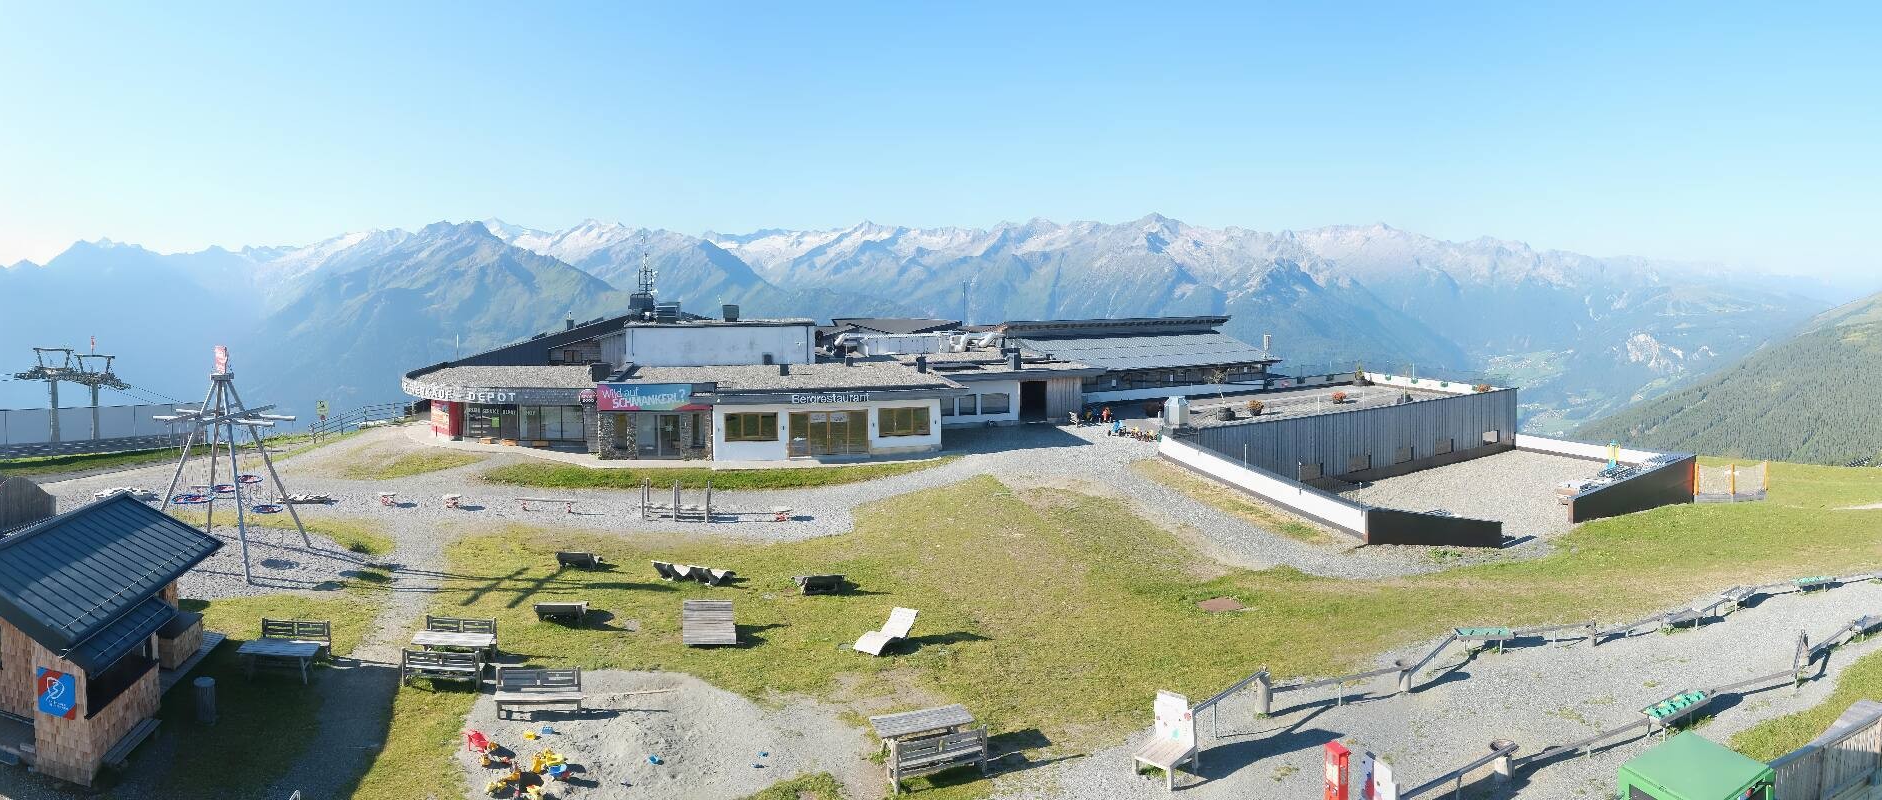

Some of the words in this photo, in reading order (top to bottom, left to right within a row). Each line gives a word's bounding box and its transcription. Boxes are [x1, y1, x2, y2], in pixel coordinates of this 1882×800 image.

[468, 392, 516, 402] DEPOT
[602, 387, 622, 399] Wild
[624, 386, 639, 398] auf
[612, 388, 686, 409] SCHMANKERL?
[791, 393, 870, 404] Bergrestaurant
